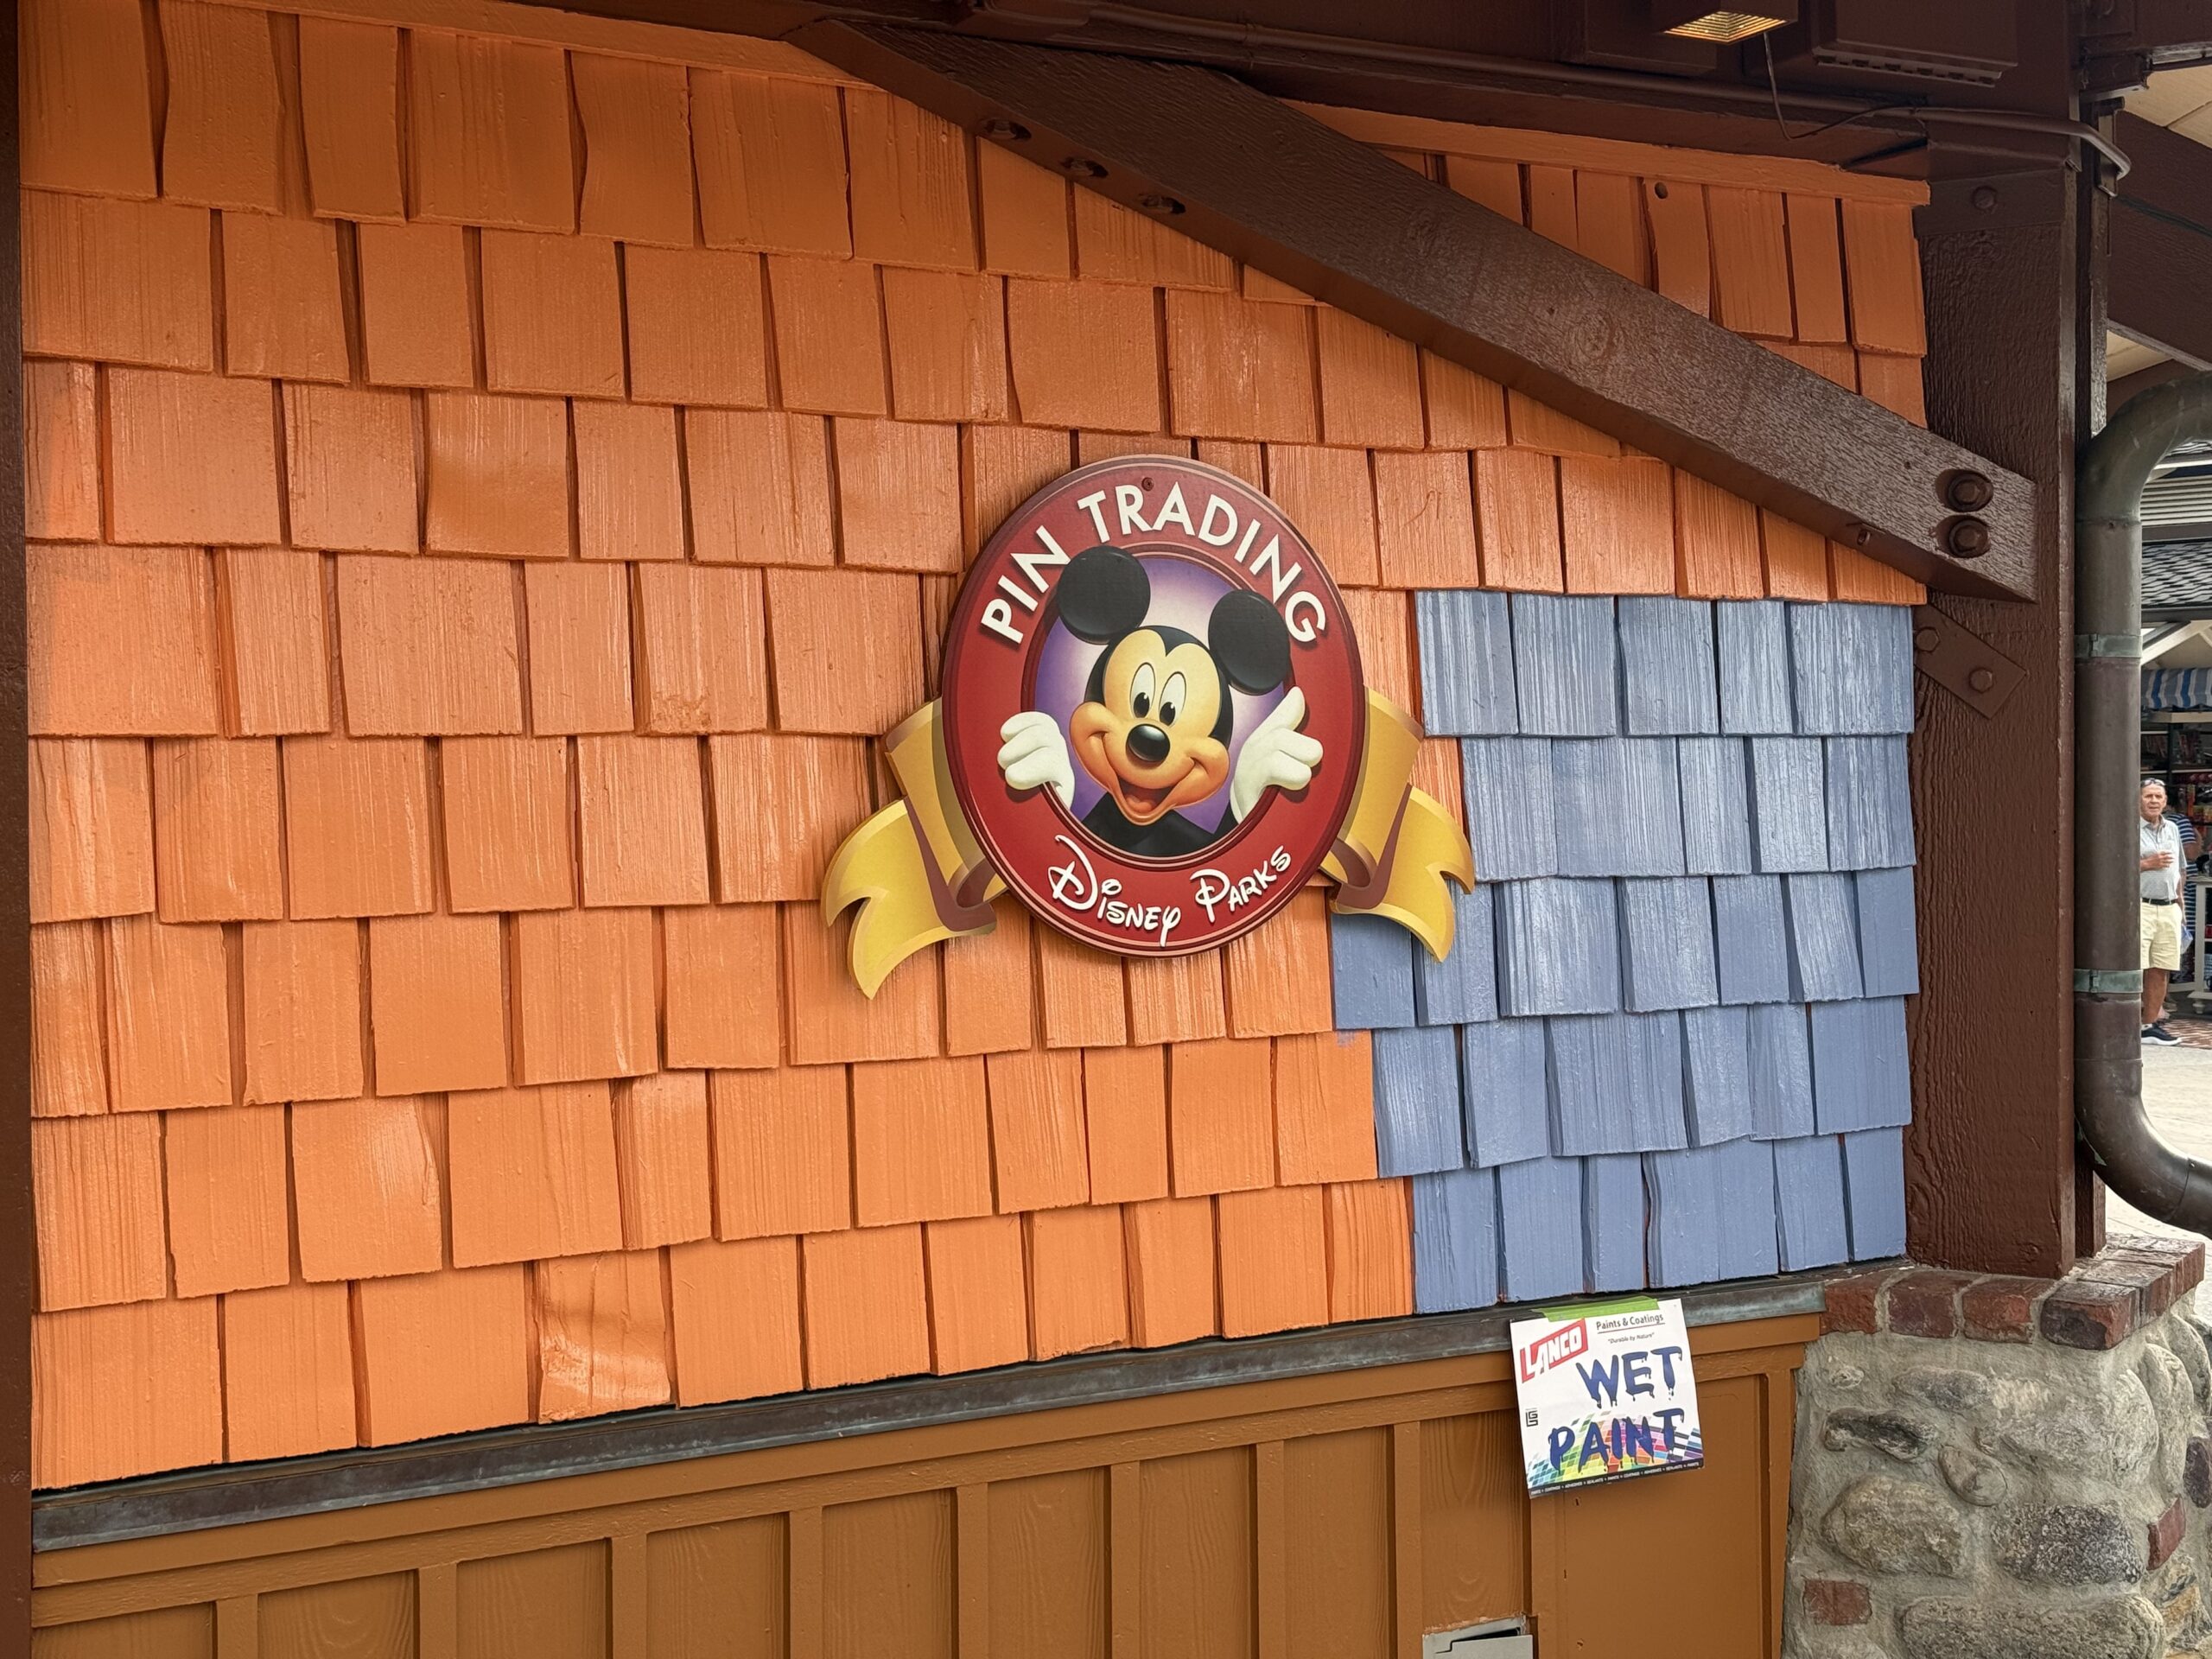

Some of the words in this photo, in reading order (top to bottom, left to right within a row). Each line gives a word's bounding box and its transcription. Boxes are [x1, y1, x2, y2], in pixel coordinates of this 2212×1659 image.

[980, 524, 1071, 644] PIN
[1077, 481, 1326, 643] TRADING
[1520, 1318, 1588, 1383] LANCO
[1596, 1320, 1621, 1331] Paints
[1622, 1317, 1629, 1326] &
[1630, 1313, 1664, 1325] Coatings
[1575, 1345, 1683, 1409] WET
[1548, 1408, 1685, 1474] PAINT
